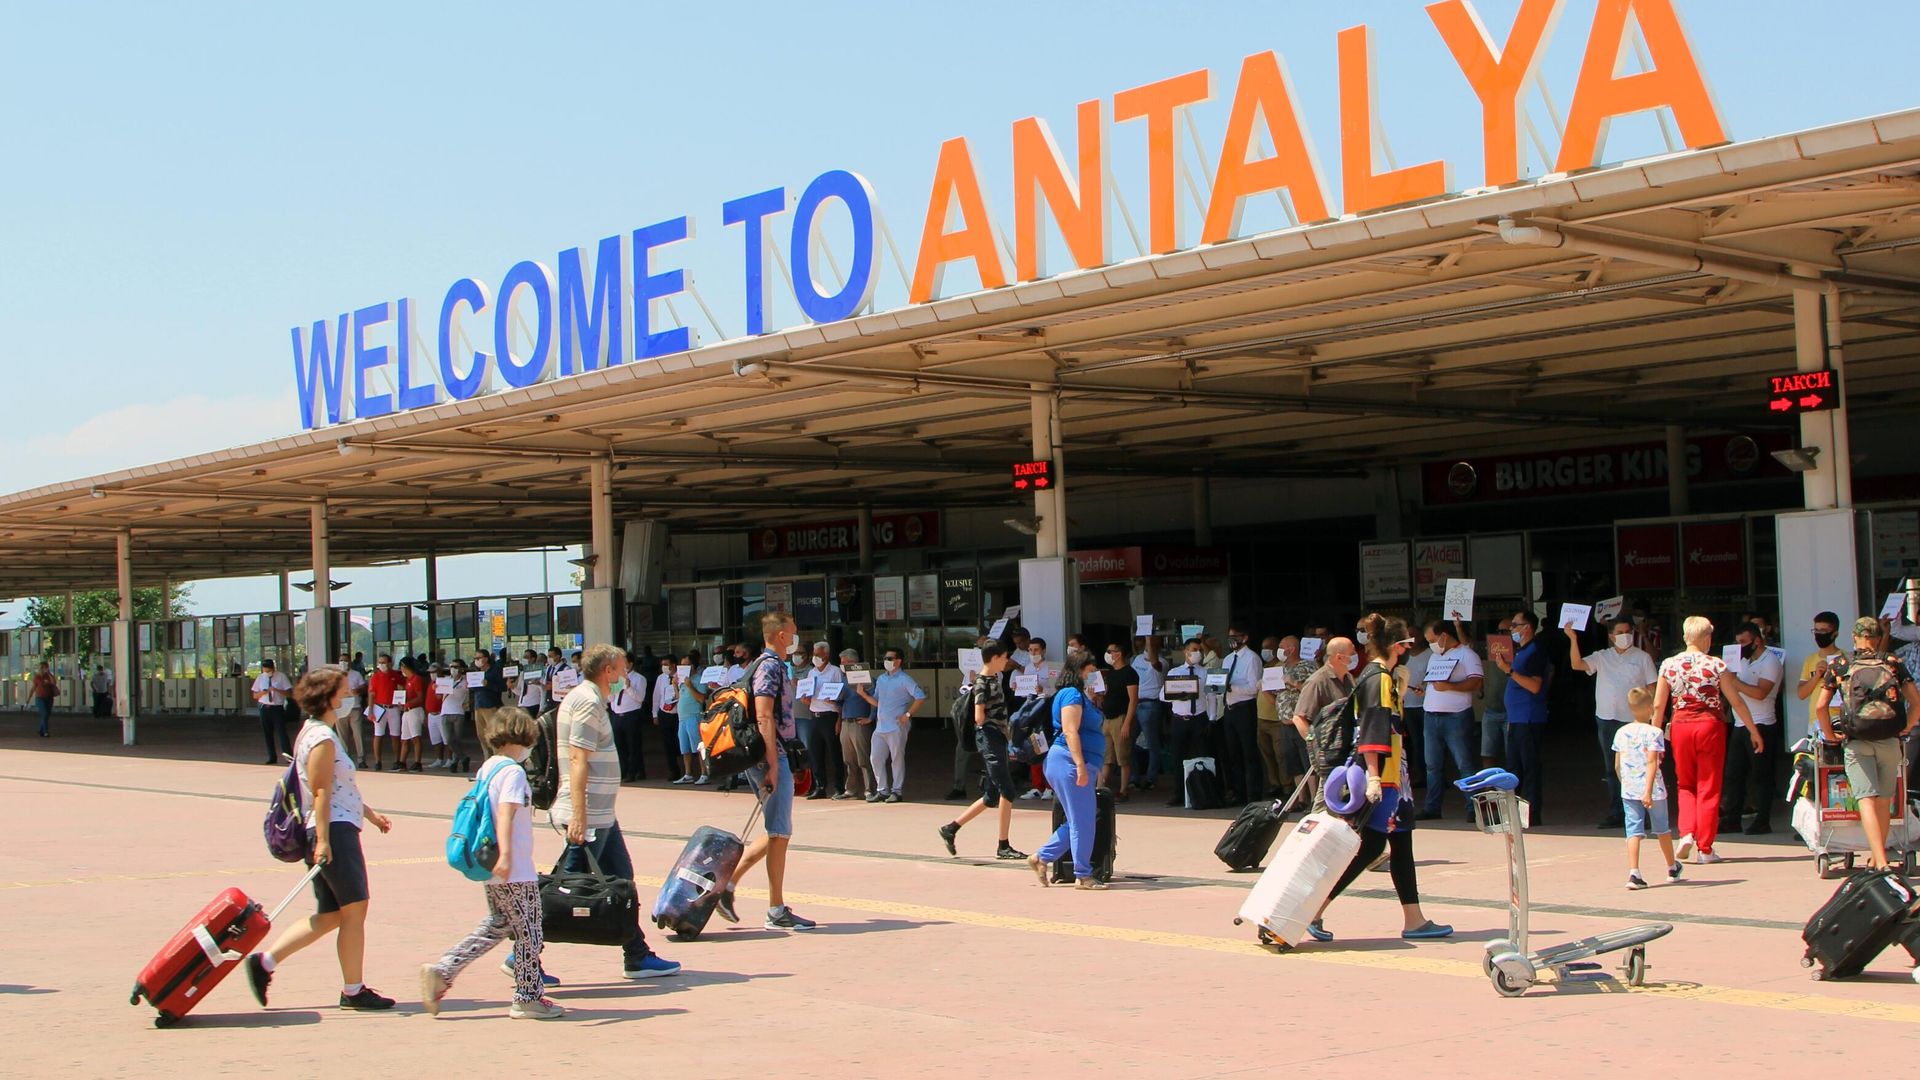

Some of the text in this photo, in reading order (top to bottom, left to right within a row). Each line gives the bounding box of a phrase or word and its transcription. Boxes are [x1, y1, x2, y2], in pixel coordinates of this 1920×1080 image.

[291, 0, 1732, 430] WELCOME TO ANTALYA
[1772, 371, 1831, 393] ТАКСИ
[1496, 453, 1614, 491] BURGER
[787, 521, 894, 551] BURGER KNG
[1169, 554, 1220, 569] vodafone
[797, 597, 822, 605] FISCHER
